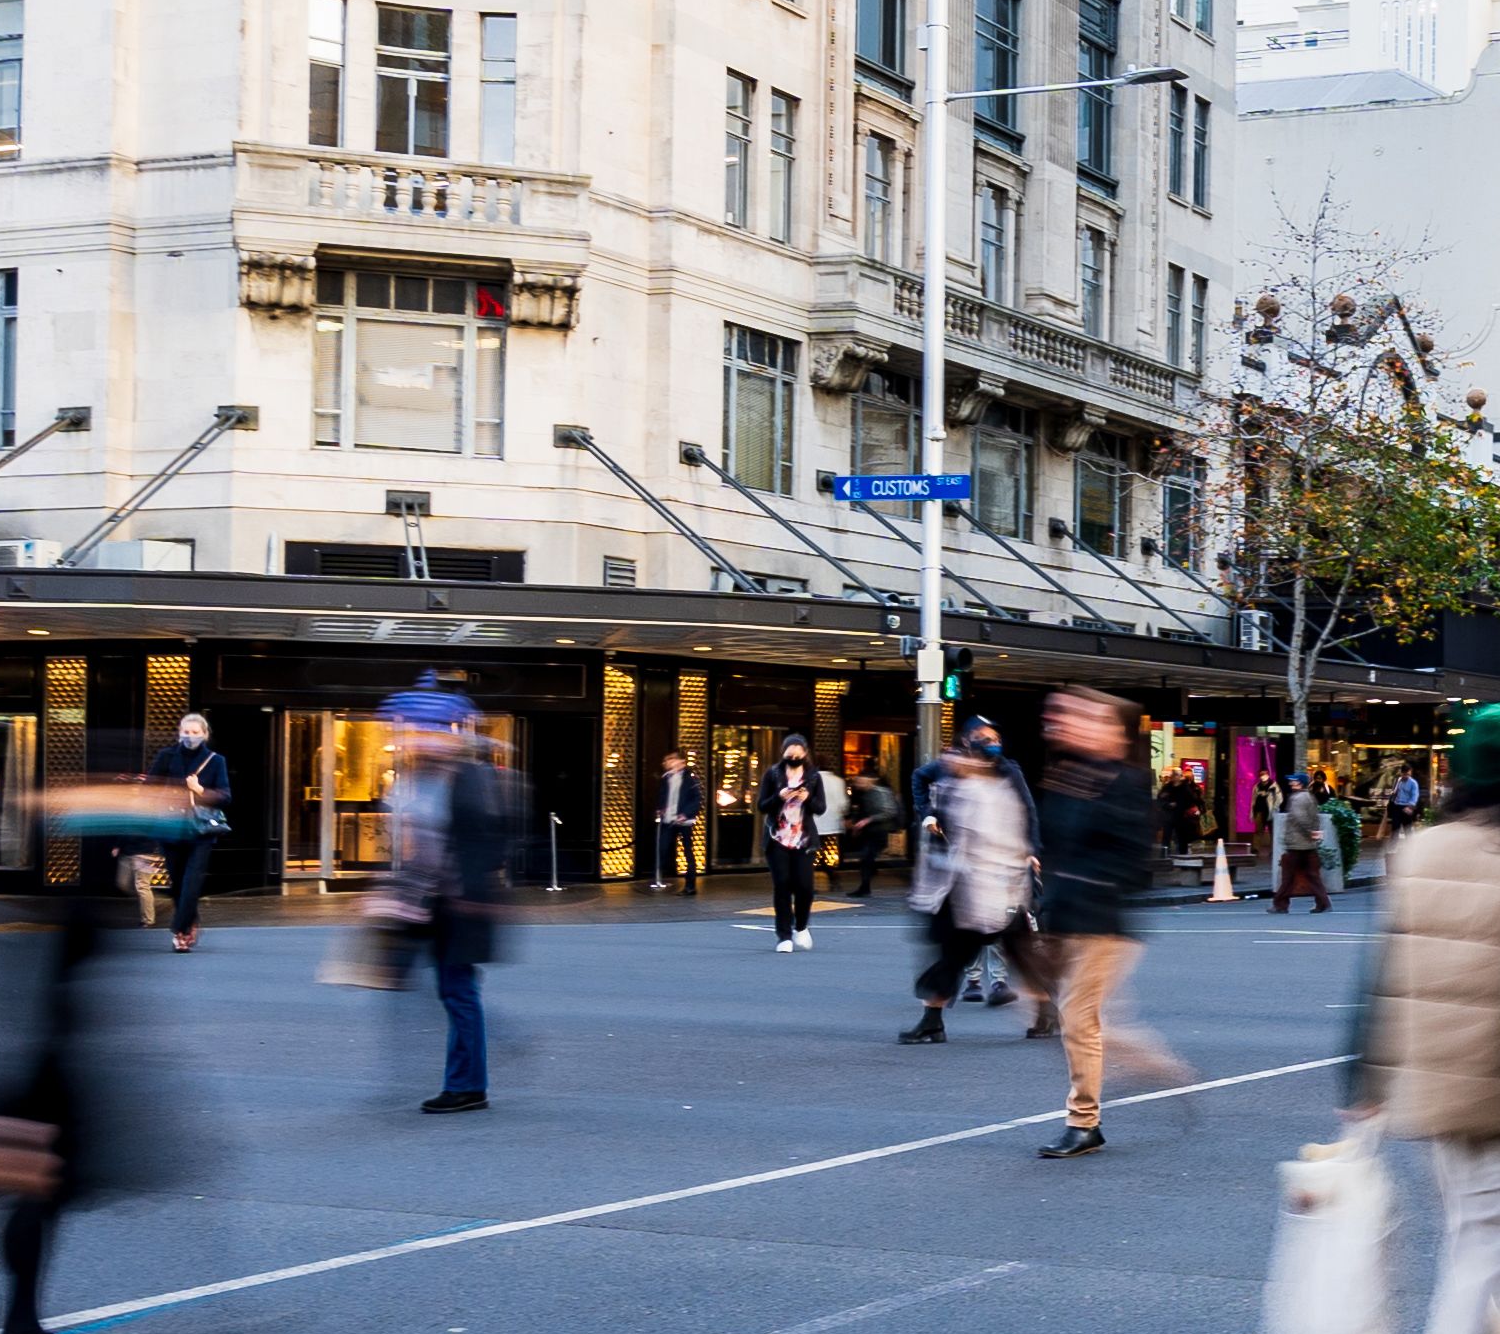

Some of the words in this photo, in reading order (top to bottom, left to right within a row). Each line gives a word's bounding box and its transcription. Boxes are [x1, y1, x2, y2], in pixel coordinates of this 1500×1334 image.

[871, 479, 930, 496] CUSTOMS
[936, 477, 945, 486] ST
[946, 477, 963, 485] EAST
